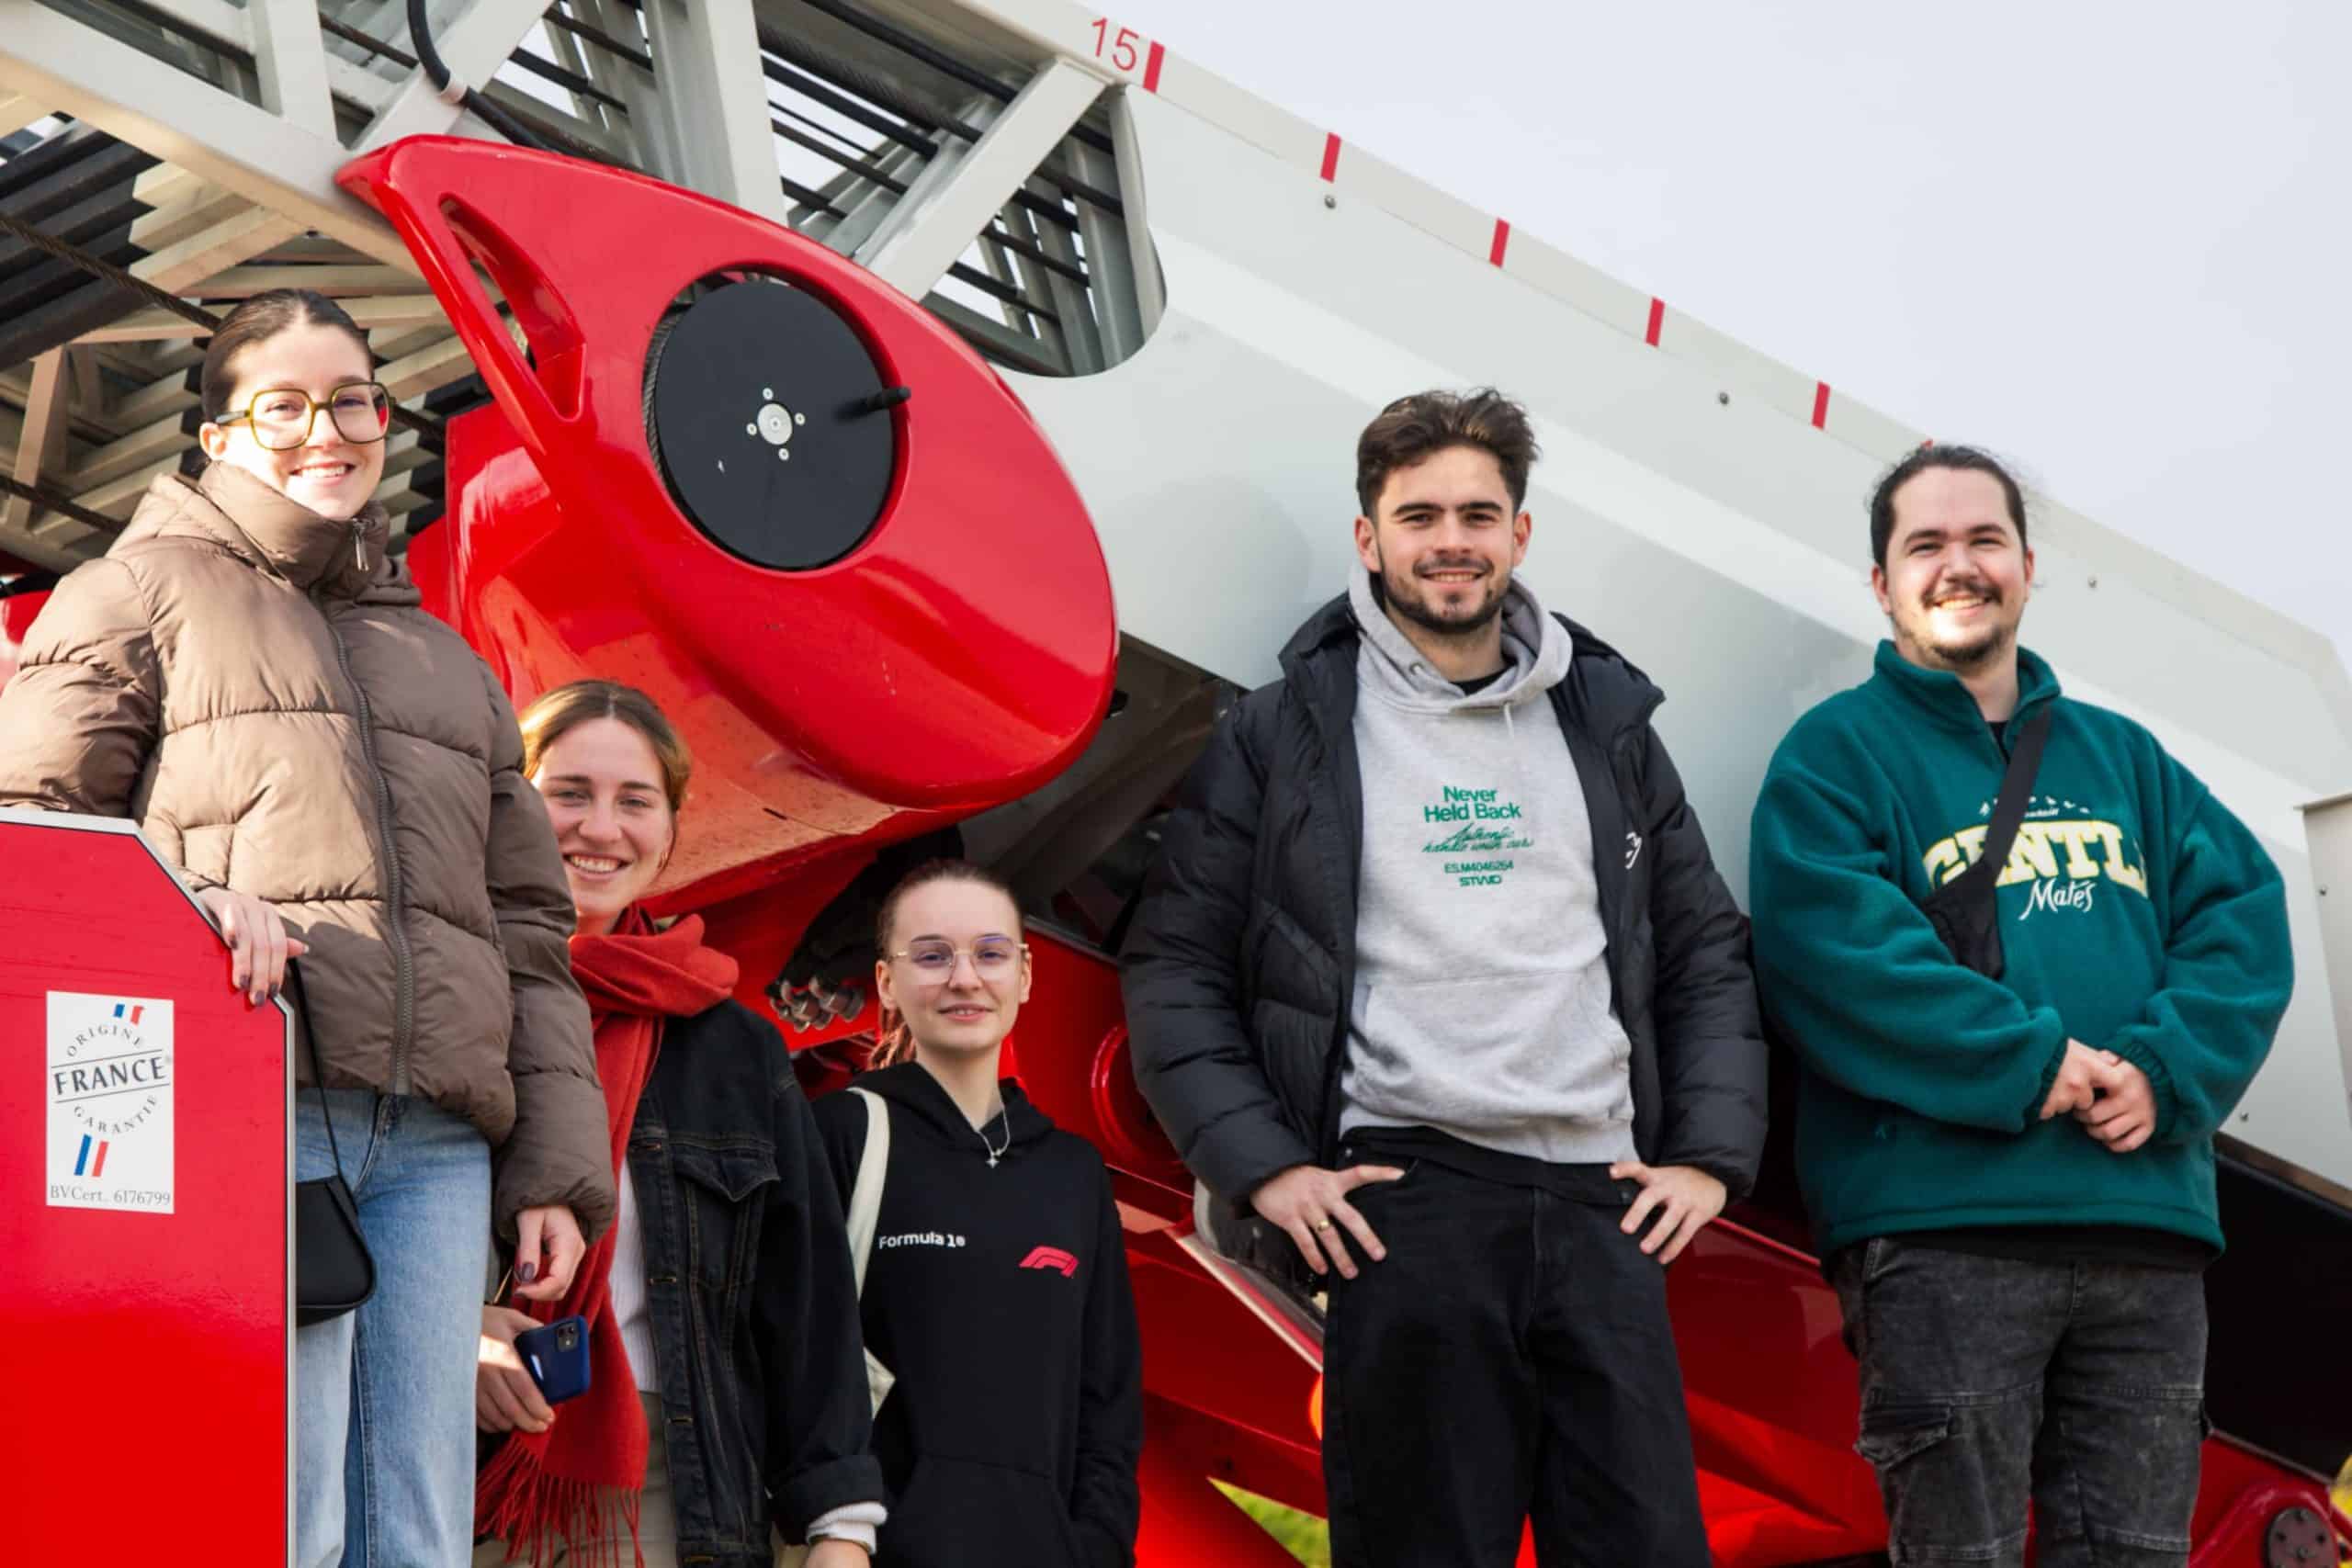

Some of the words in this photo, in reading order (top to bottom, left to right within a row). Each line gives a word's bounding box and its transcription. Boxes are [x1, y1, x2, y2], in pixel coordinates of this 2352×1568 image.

[1091, 17, 1139, 71] 15
[1442, 785, 1498, 802] Never
[1423, 803, 1470, 822] Held
[1474, 801, 1521, 819] Back
[1459, 874, 1503, 886] STWD
[66, 1024, 144, 1057] ORIGINE
[53, 1056, 166, 1095] FRANCE
[74, 1095, 157, 1134] GARANTIE
[878, 1231, 944, 1249] Formula
